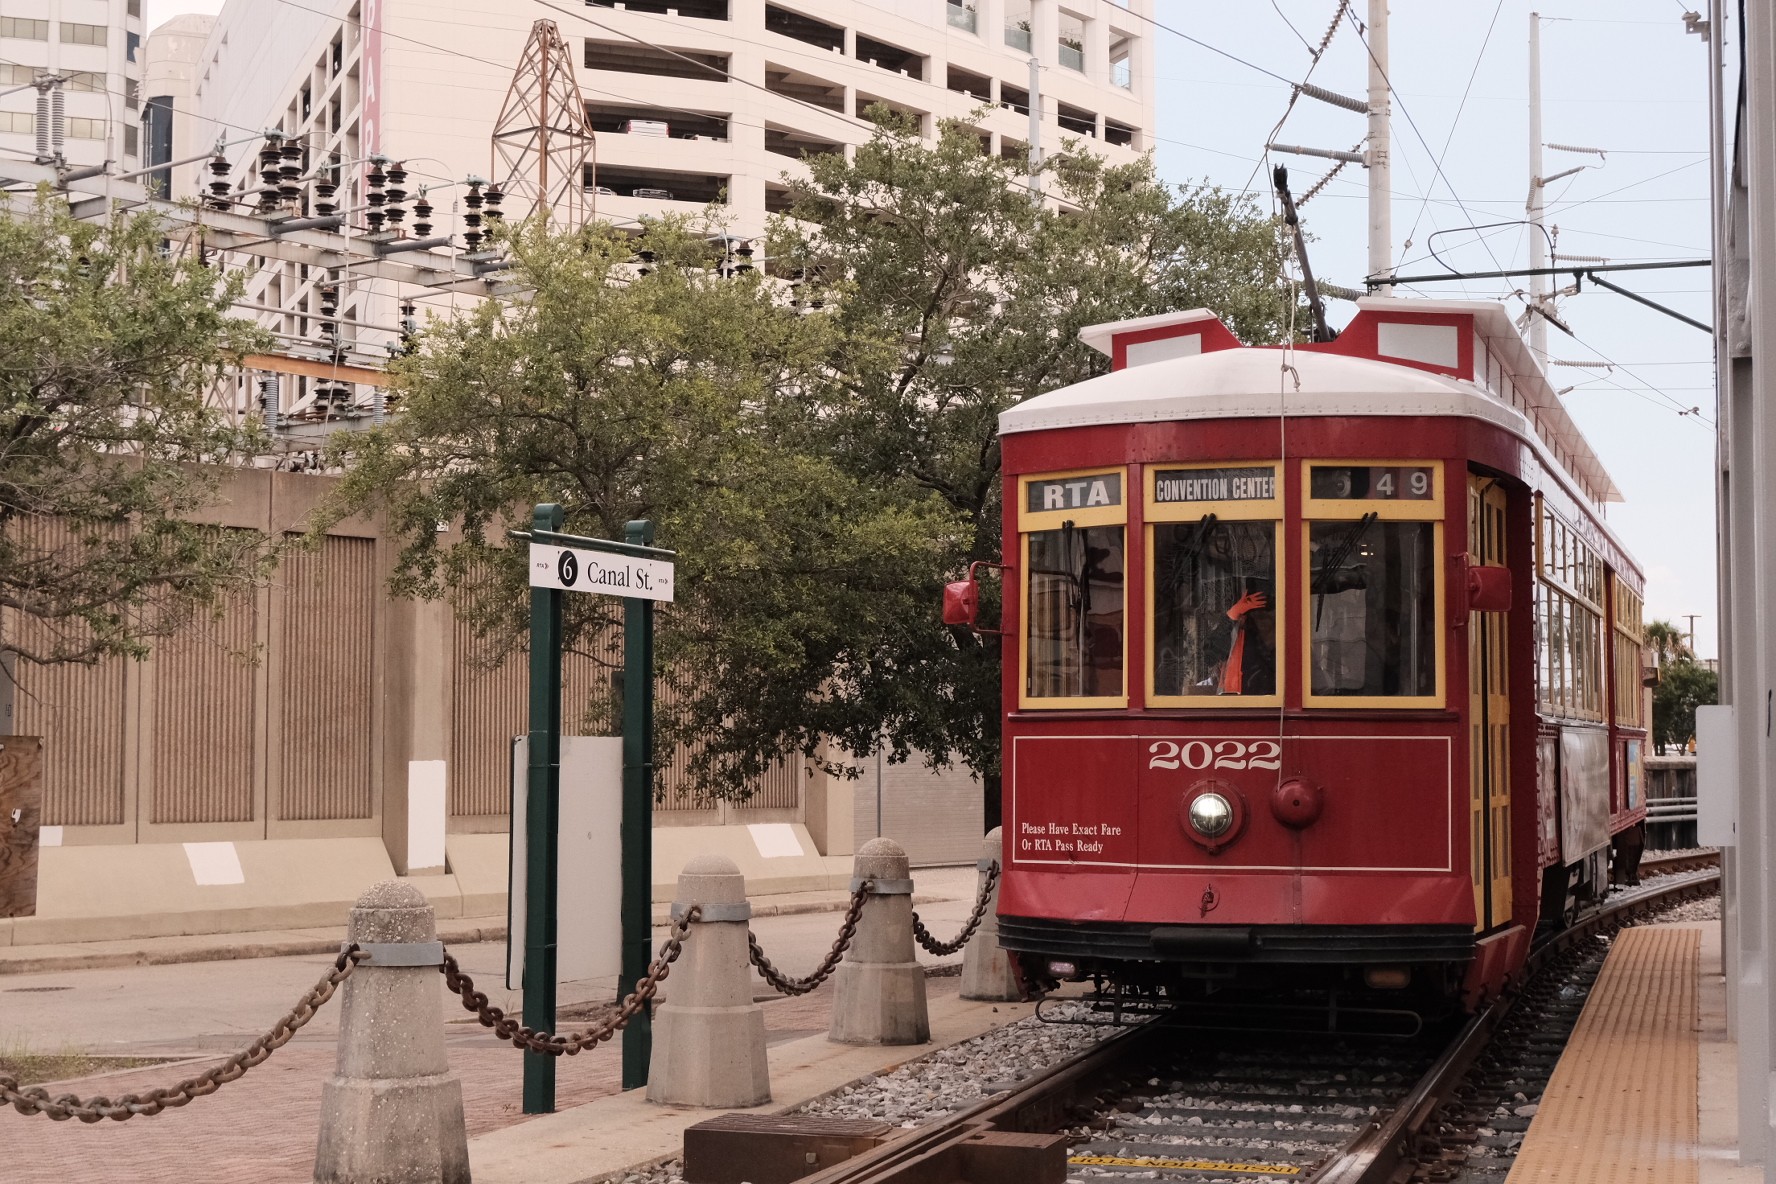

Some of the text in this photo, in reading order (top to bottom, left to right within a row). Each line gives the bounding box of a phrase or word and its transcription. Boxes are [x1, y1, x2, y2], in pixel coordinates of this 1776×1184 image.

[1043, 481, 1110, 509] RTA
[1156, 477, 1275, 501] CONVENTION CENTER
[562, 556, 653, 591] 6 Canal St.
[1149, 741, 1280, 770] 2022
[1022, 822, 1122, 836] Please Have Exact Fare
[1021, 838, 1104, 854] Or RTA Pass Ready
